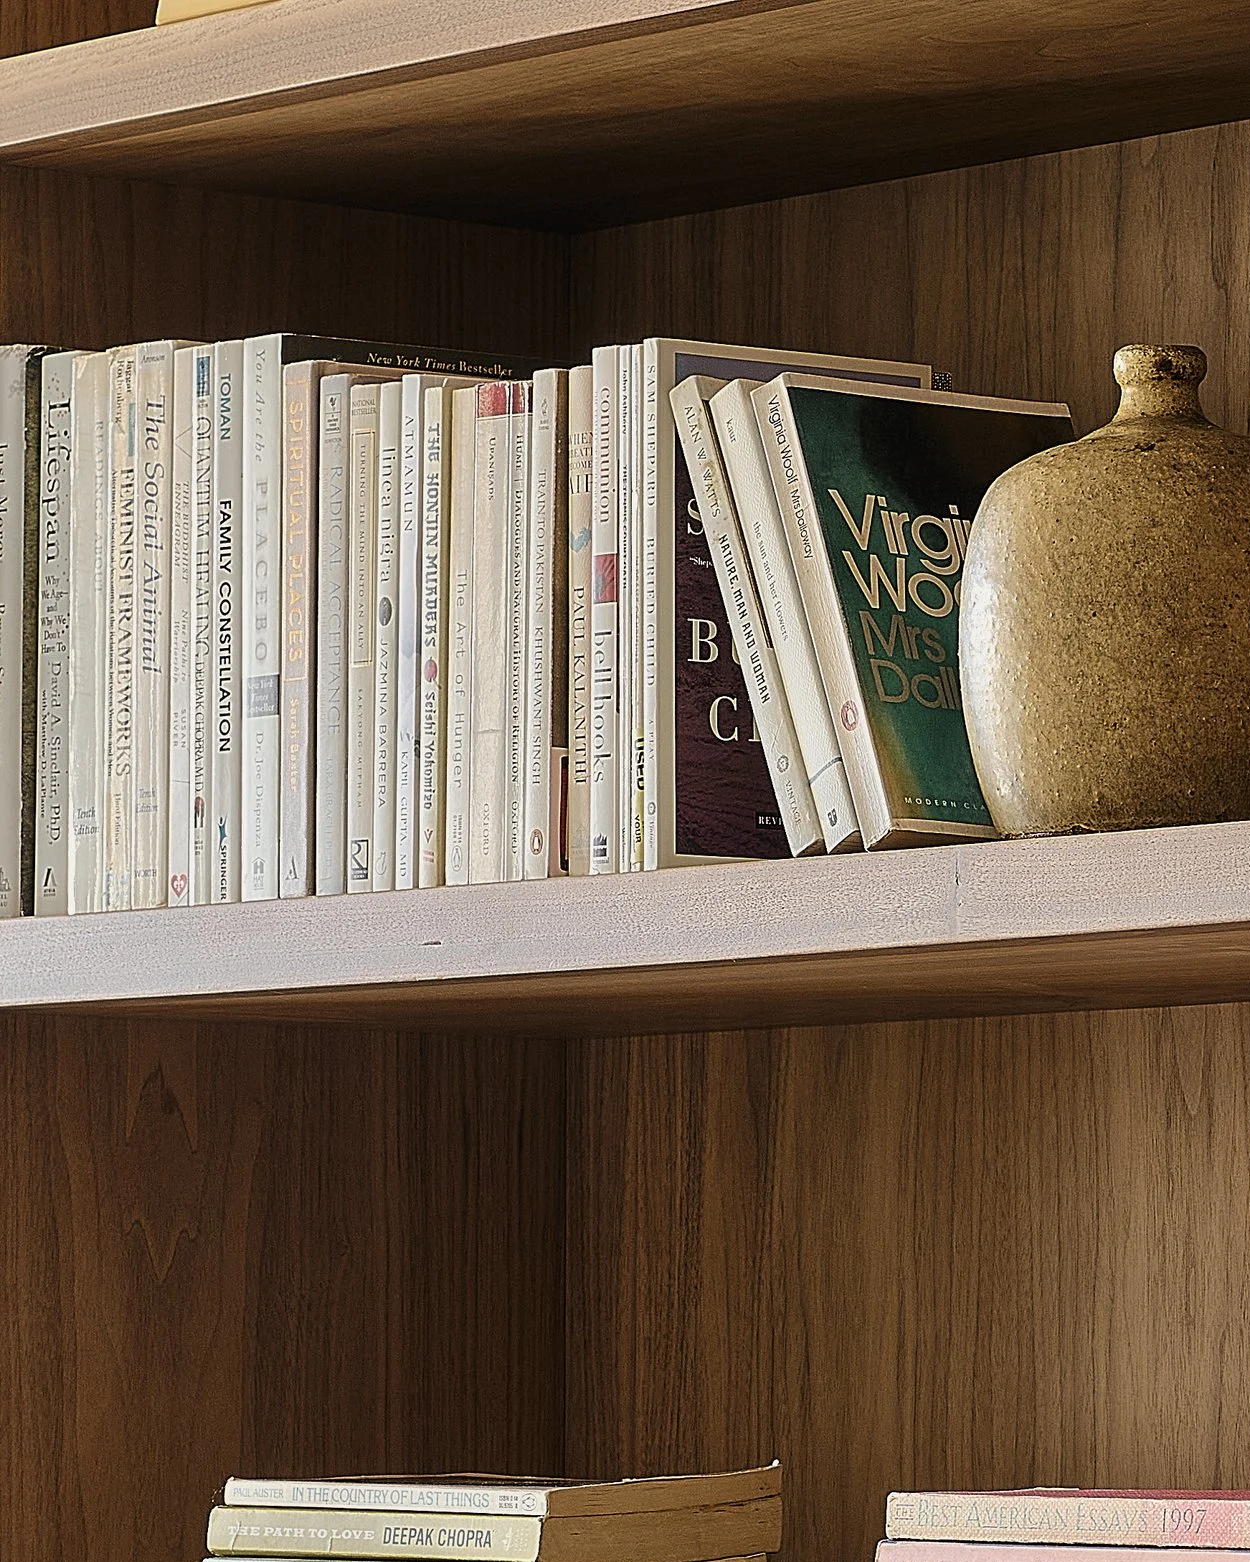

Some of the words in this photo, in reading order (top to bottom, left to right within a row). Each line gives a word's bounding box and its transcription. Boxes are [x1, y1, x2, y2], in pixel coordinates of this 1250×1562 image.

[220, 373, 232, 440] TOMAN
[647, 366, 655, 402] SAM
[145, 395, 166, 450] The
[428, 423, 439, 462] THE
[647, 414, 655, 506] SHEPARD
[767, 394, 789, 445] Virginia
[780, 444, 798, 484] Woolf
[42, 401, 70, 564] Lifespan
[684, 406, 701, 443] ALAN
[696, 447, 707, 466] W.
[703, 470, 721, 518] WATTS
[143, 462, 164, 551] Social
[220, 500, 232, 573] FAMILY
[426, 474, 439, 547] HONJIN
[424, 554, 438, 647] MURDERS
[457, 570, 467, 606] The
[647, 538, 655, 614] BURIED
[142, 562, 163, 674] Animal
[455, 624, 466, 659] Art
[572, 587, 585, 646] PAUL
[218, 582, 232, 752] CONSTELLATION
[379, 639, 389, 717] JAZMINA
[455, 675, 465, 697] of
[594, 630, 612, 682] bell
[647, 623, 655, 686] CHILD
[454, 713, 465, 788] Hunger
[572, 654, 588, 784] KALANITHI
[593, 696, 611, 783] hooks
[378, 725, 387, 807] BARRERA
[383, 1527, 434, 1545] DEEPAK
[438, 1529, 491, 1548] CHOPRA
